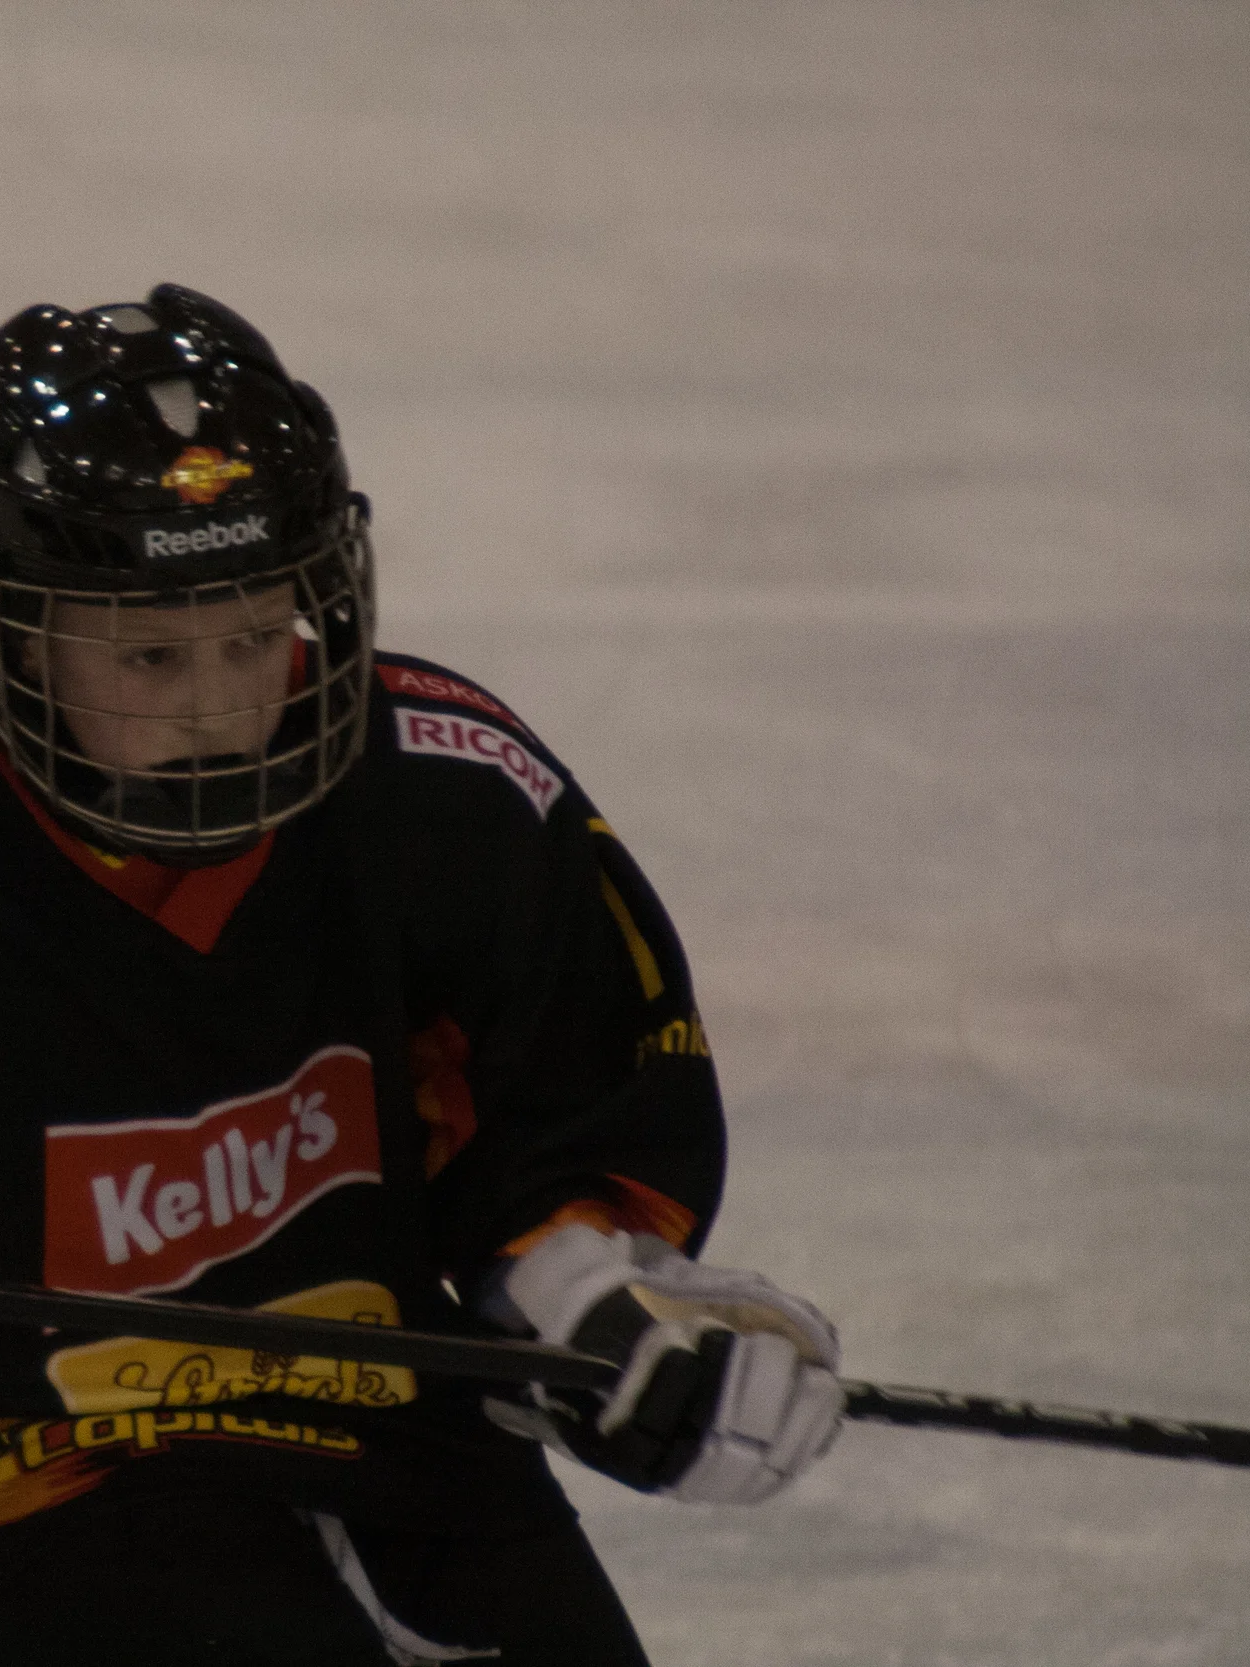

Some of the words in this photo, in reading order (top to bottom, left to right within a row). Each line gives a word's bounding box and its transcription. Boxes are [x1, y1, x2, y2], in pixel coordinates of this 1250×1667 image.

[143, 514, 270, 558] Reebok
[408, 715, 553, 797] RICOH
[90, 1091, 339, 1266] Kelly's
